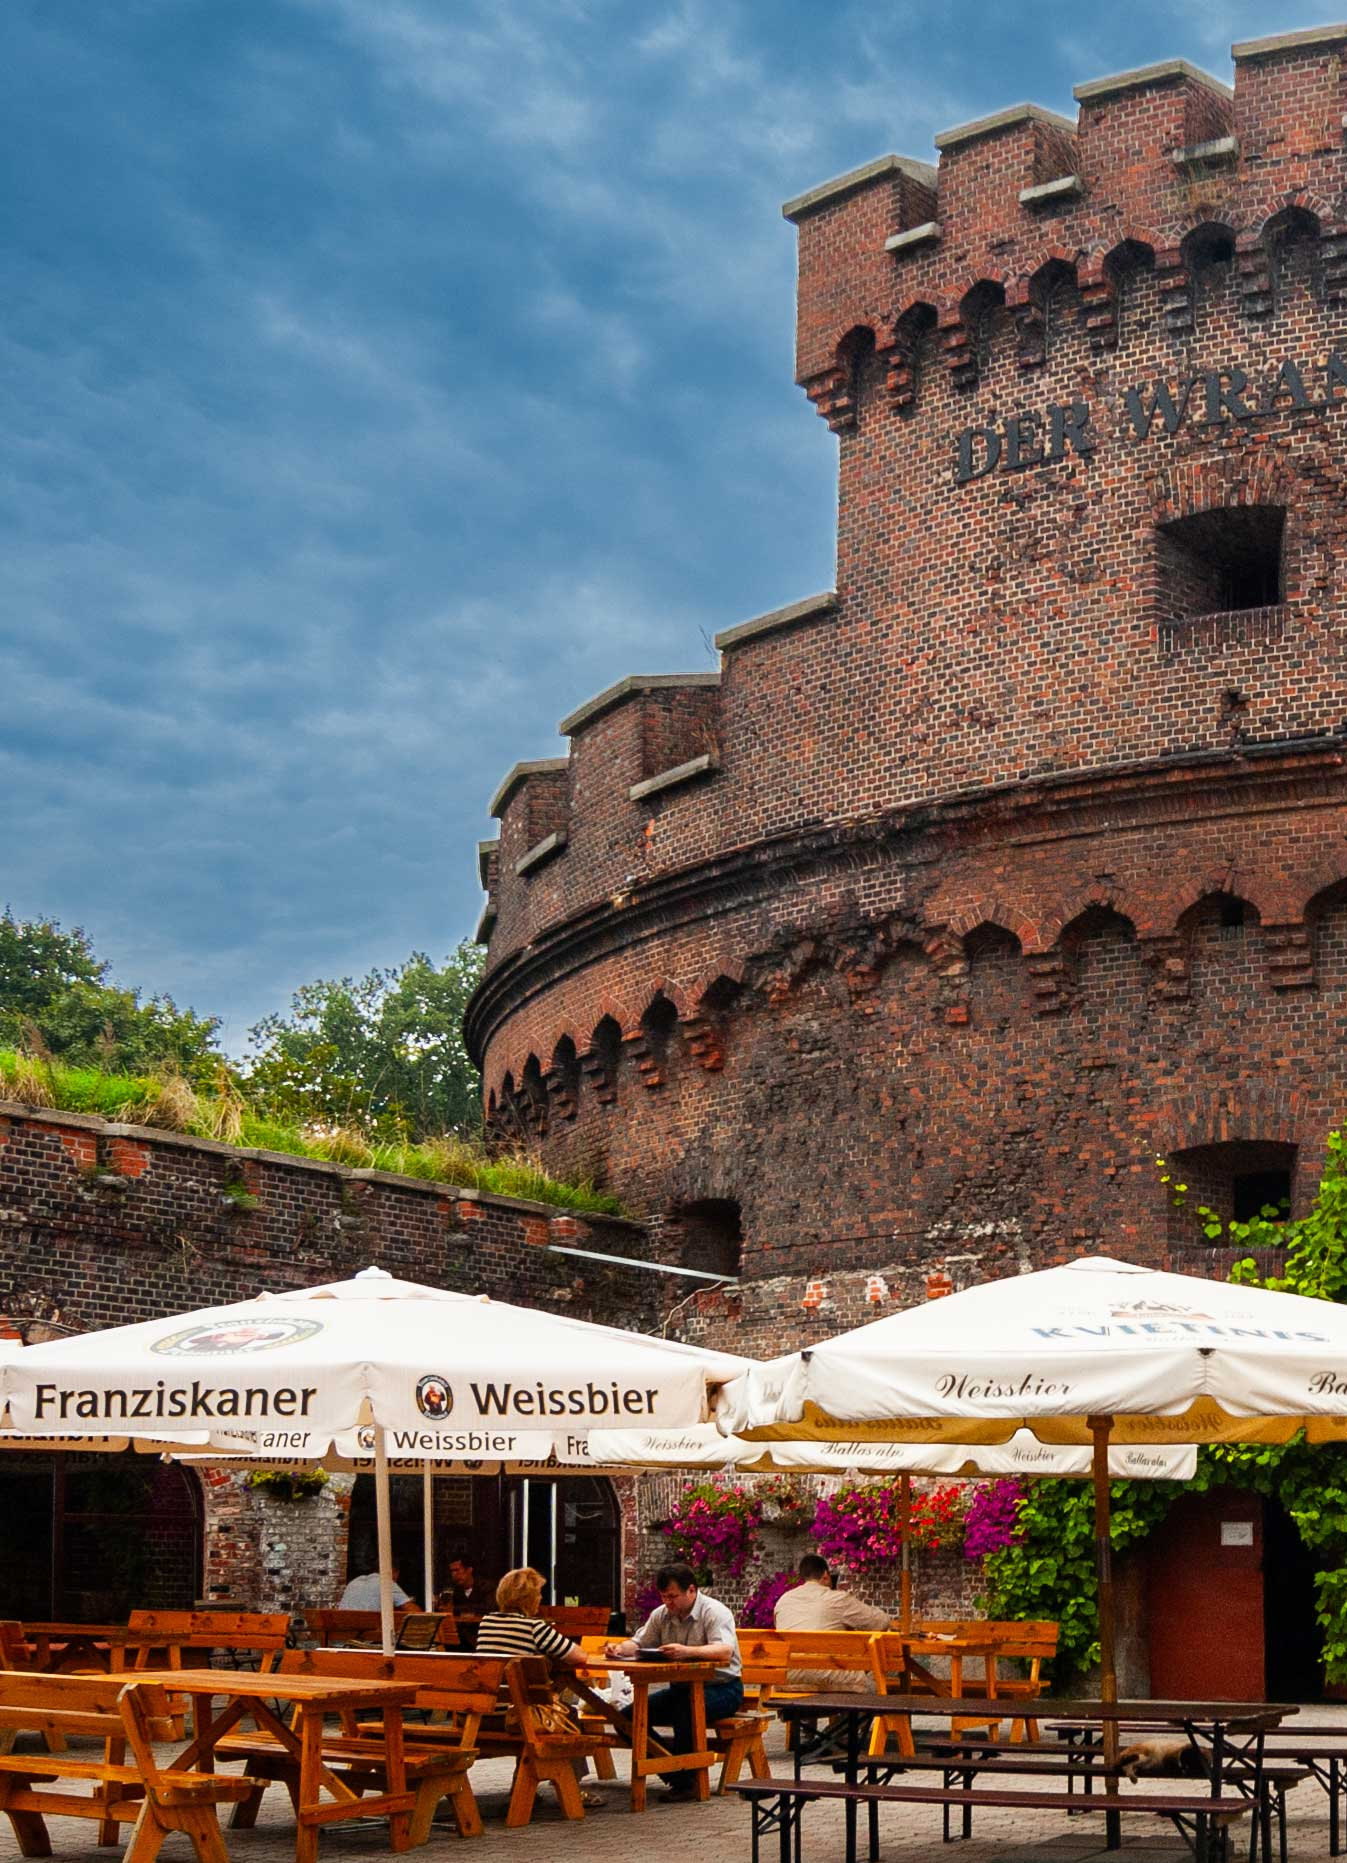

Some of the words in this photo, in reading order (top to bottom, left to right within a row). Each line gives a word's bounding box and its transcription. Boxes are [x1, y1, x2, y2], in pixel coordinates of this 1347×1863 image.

[953, 400, 1096, 484] DER
[1029, 1321, 1331, 1343] KVIETINIS
[33, 1379, 318, 1420] Franziskaner
[469, 1380, 660, 1416] Weissbier
[934, 1373, 1077, 1400] Weissbier
[261, 1431, 312, 1449] aner
[394, 1430, 518, 1451] Weissbier
